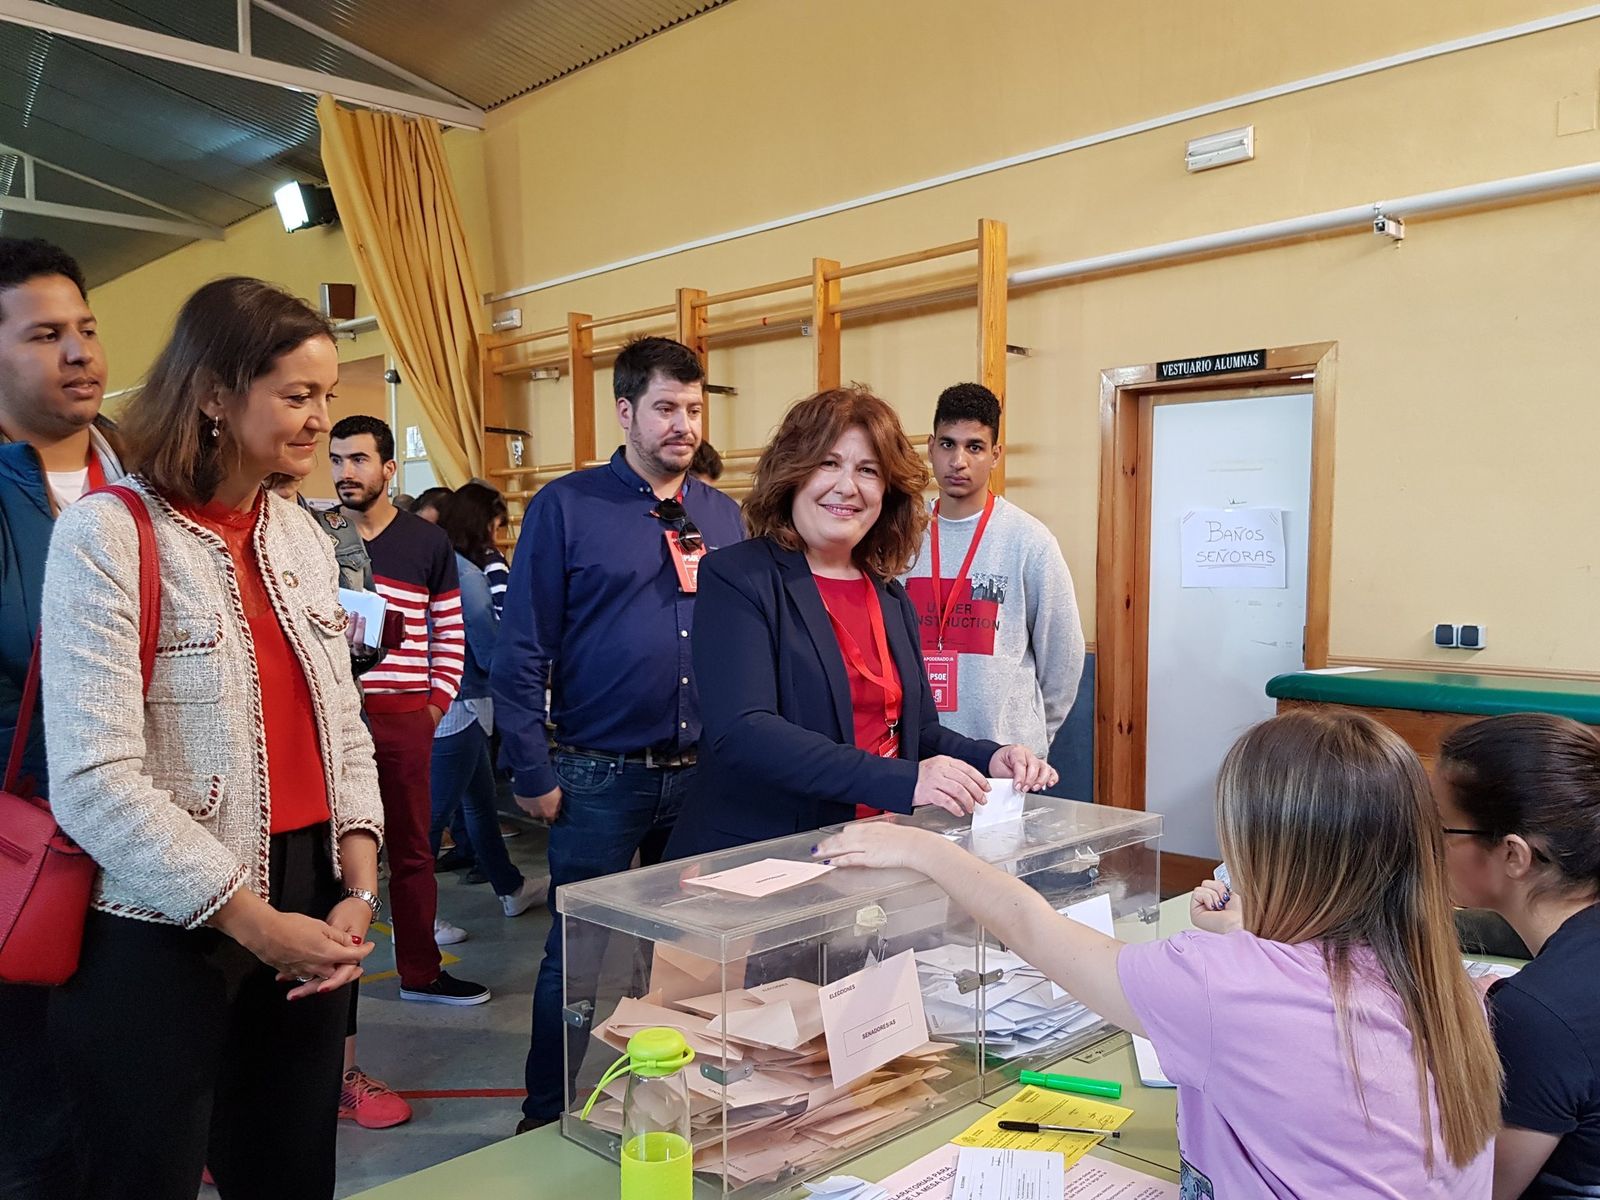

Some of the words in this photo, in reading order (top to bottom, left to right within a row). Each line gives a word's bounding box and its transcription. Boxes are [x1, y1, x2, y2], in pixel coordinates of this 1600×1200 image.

[1162, 359, 1212, 377] VESTUARIO
[1214, 353, 1259, 371] ALUMNAS
[1195, 548, 1276, 563] SEÑORAS
[927, 602, 972, 614] UER
[930, 672, 947, 681] PSOE
[829, 983, 856, 1000] ELECCIONES
[931, 1165, 953, 1178] PARA
[920, 1180, 942, 1194] MESA
